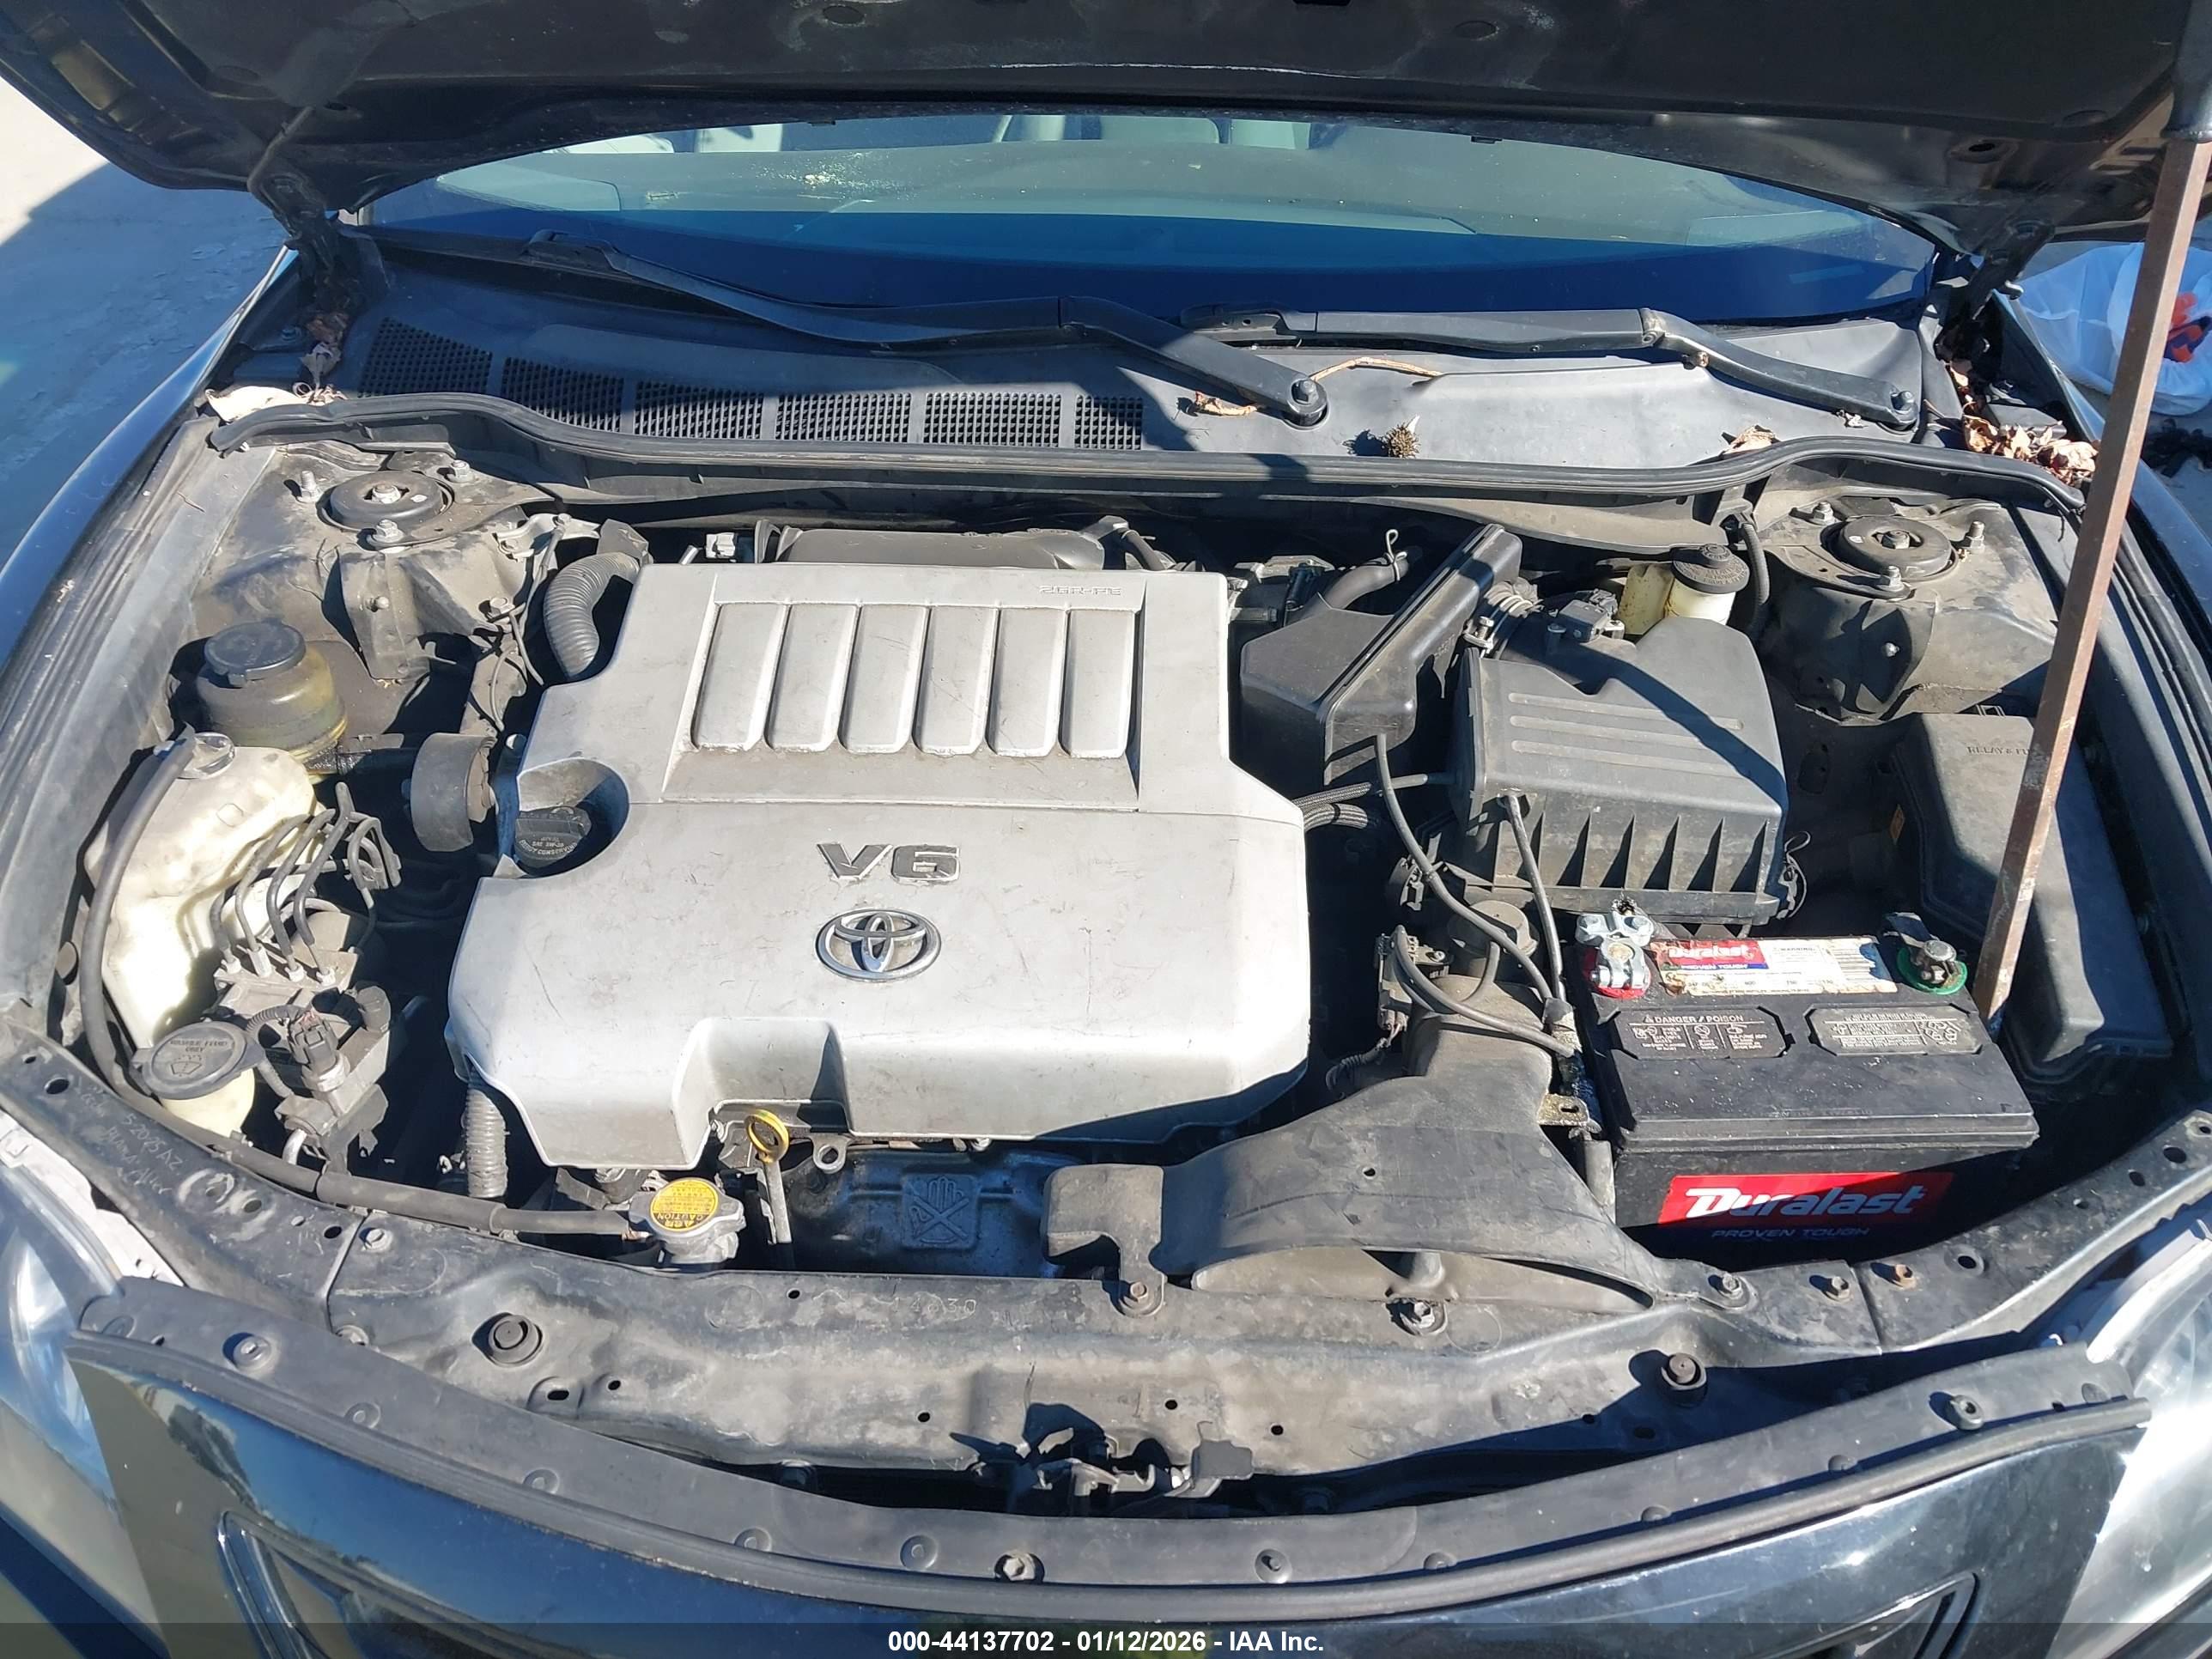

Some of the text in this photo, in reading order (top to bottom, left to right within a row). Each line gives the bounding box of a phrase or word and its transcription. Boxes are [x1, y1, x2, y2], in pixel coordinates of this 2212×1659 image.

[817, 842, 961, 882] V6
[1685, 1185, 1928, 1218] Duralast
[1711, 1227, 1870, 1238] PROVEN TOUGH
